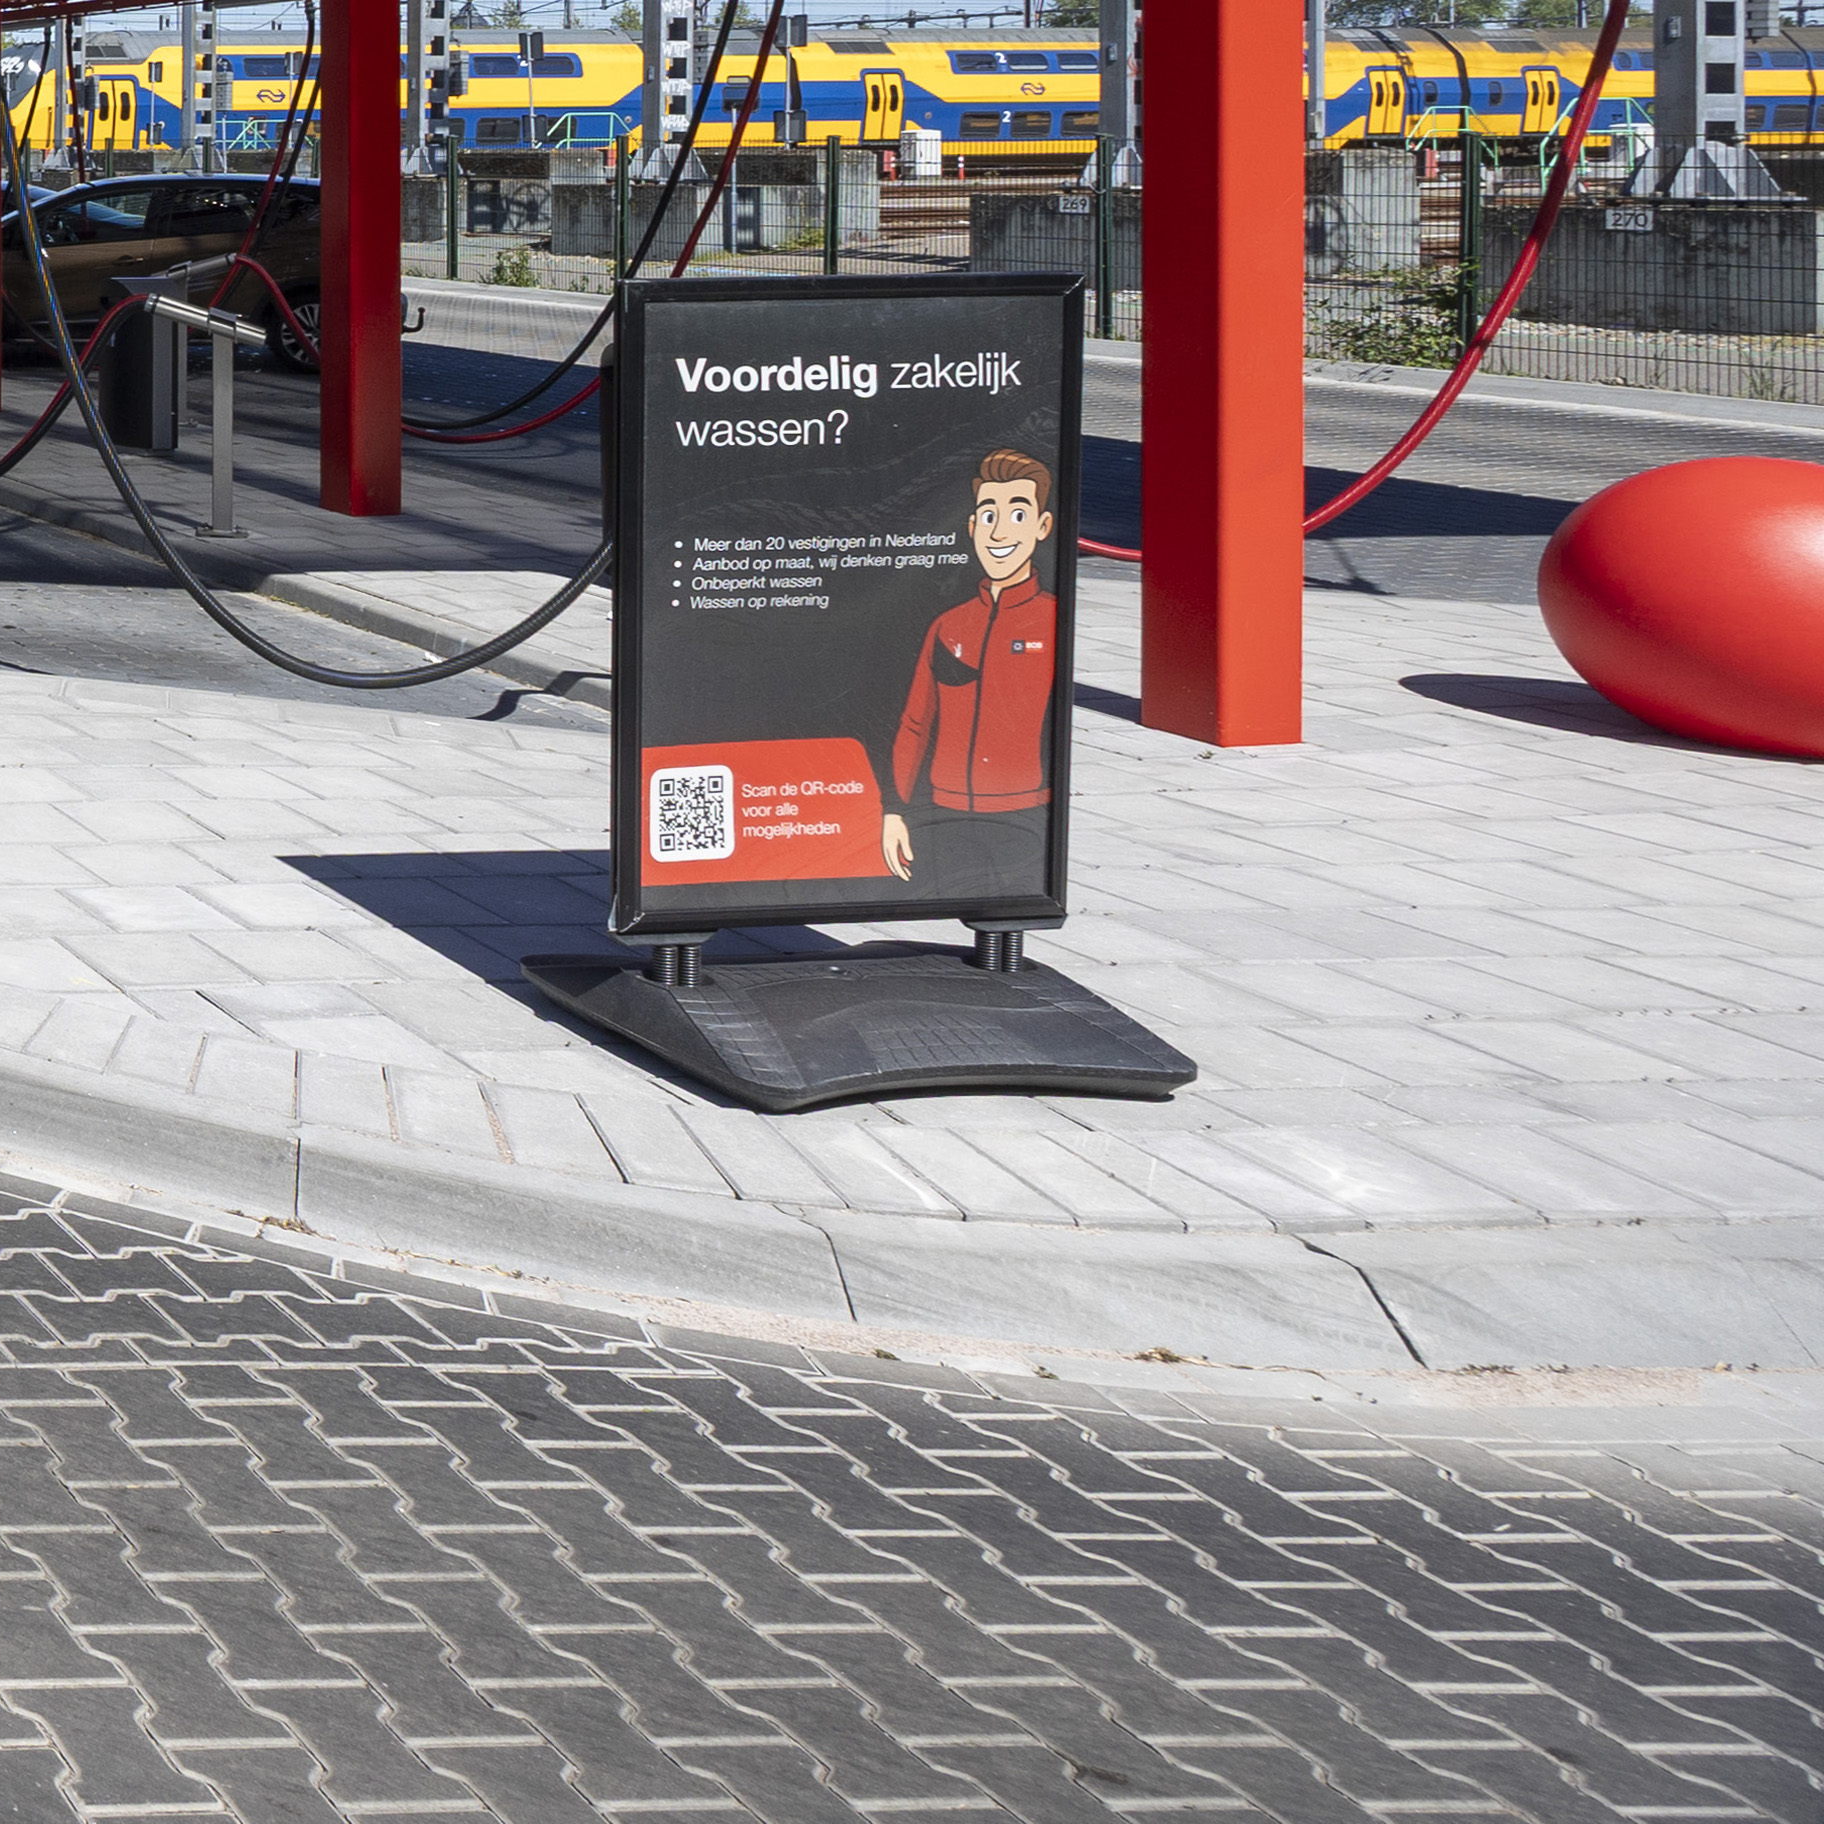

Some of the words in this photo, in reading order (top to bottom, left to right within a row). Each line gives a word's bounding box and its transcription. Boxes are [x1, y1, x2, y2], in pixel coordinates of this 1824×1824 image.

[995, 52, 1007, 64] 2
[1002, 110, 1012, 123] 2
[1062, 198, 1088, 210] 269
[1612, 212, 1648, 227] 270
[675, 355, 878, 398] Voordelig
[890, 352, 1022, 395] zakelijk
[675, 409, 850, 447] wassen?
[694, 538, 730, 552] Meer
[735, 537, 762, 551] dan
[765, 537, 785, 551] 20
[788, 535, 866, 553] vestigingen
[869, 534, 882, 548] in
[885, 532, 957, 547] Nederland
[692, 557, 750, 571] Aanbod
[752, 559, 772, 573] op
[775, 556, 815, 570] maat,
[818, 555, 838, 571] wij
[840, 554, 892, 568] denken
[894, 555, 935, 569] graag
[937, 553, 969, 565] mee
[691, 576, 765, 592] Onbeperkt
[769, 576, 823, 589] wassen
[689, 596, 745, 609] Wassen
[747, 597, 767, 611] op
[770, 594, 830, 609] rekening
[741, 783, 777, 798] Scan
[779, 782, 798, 796] de
[801, 780, 864, 795] QR-code
[741, 806, 773, 818] voor
[775, 802, 799, 816] alle
[742, 821, 841, 840] mogelijkheden
